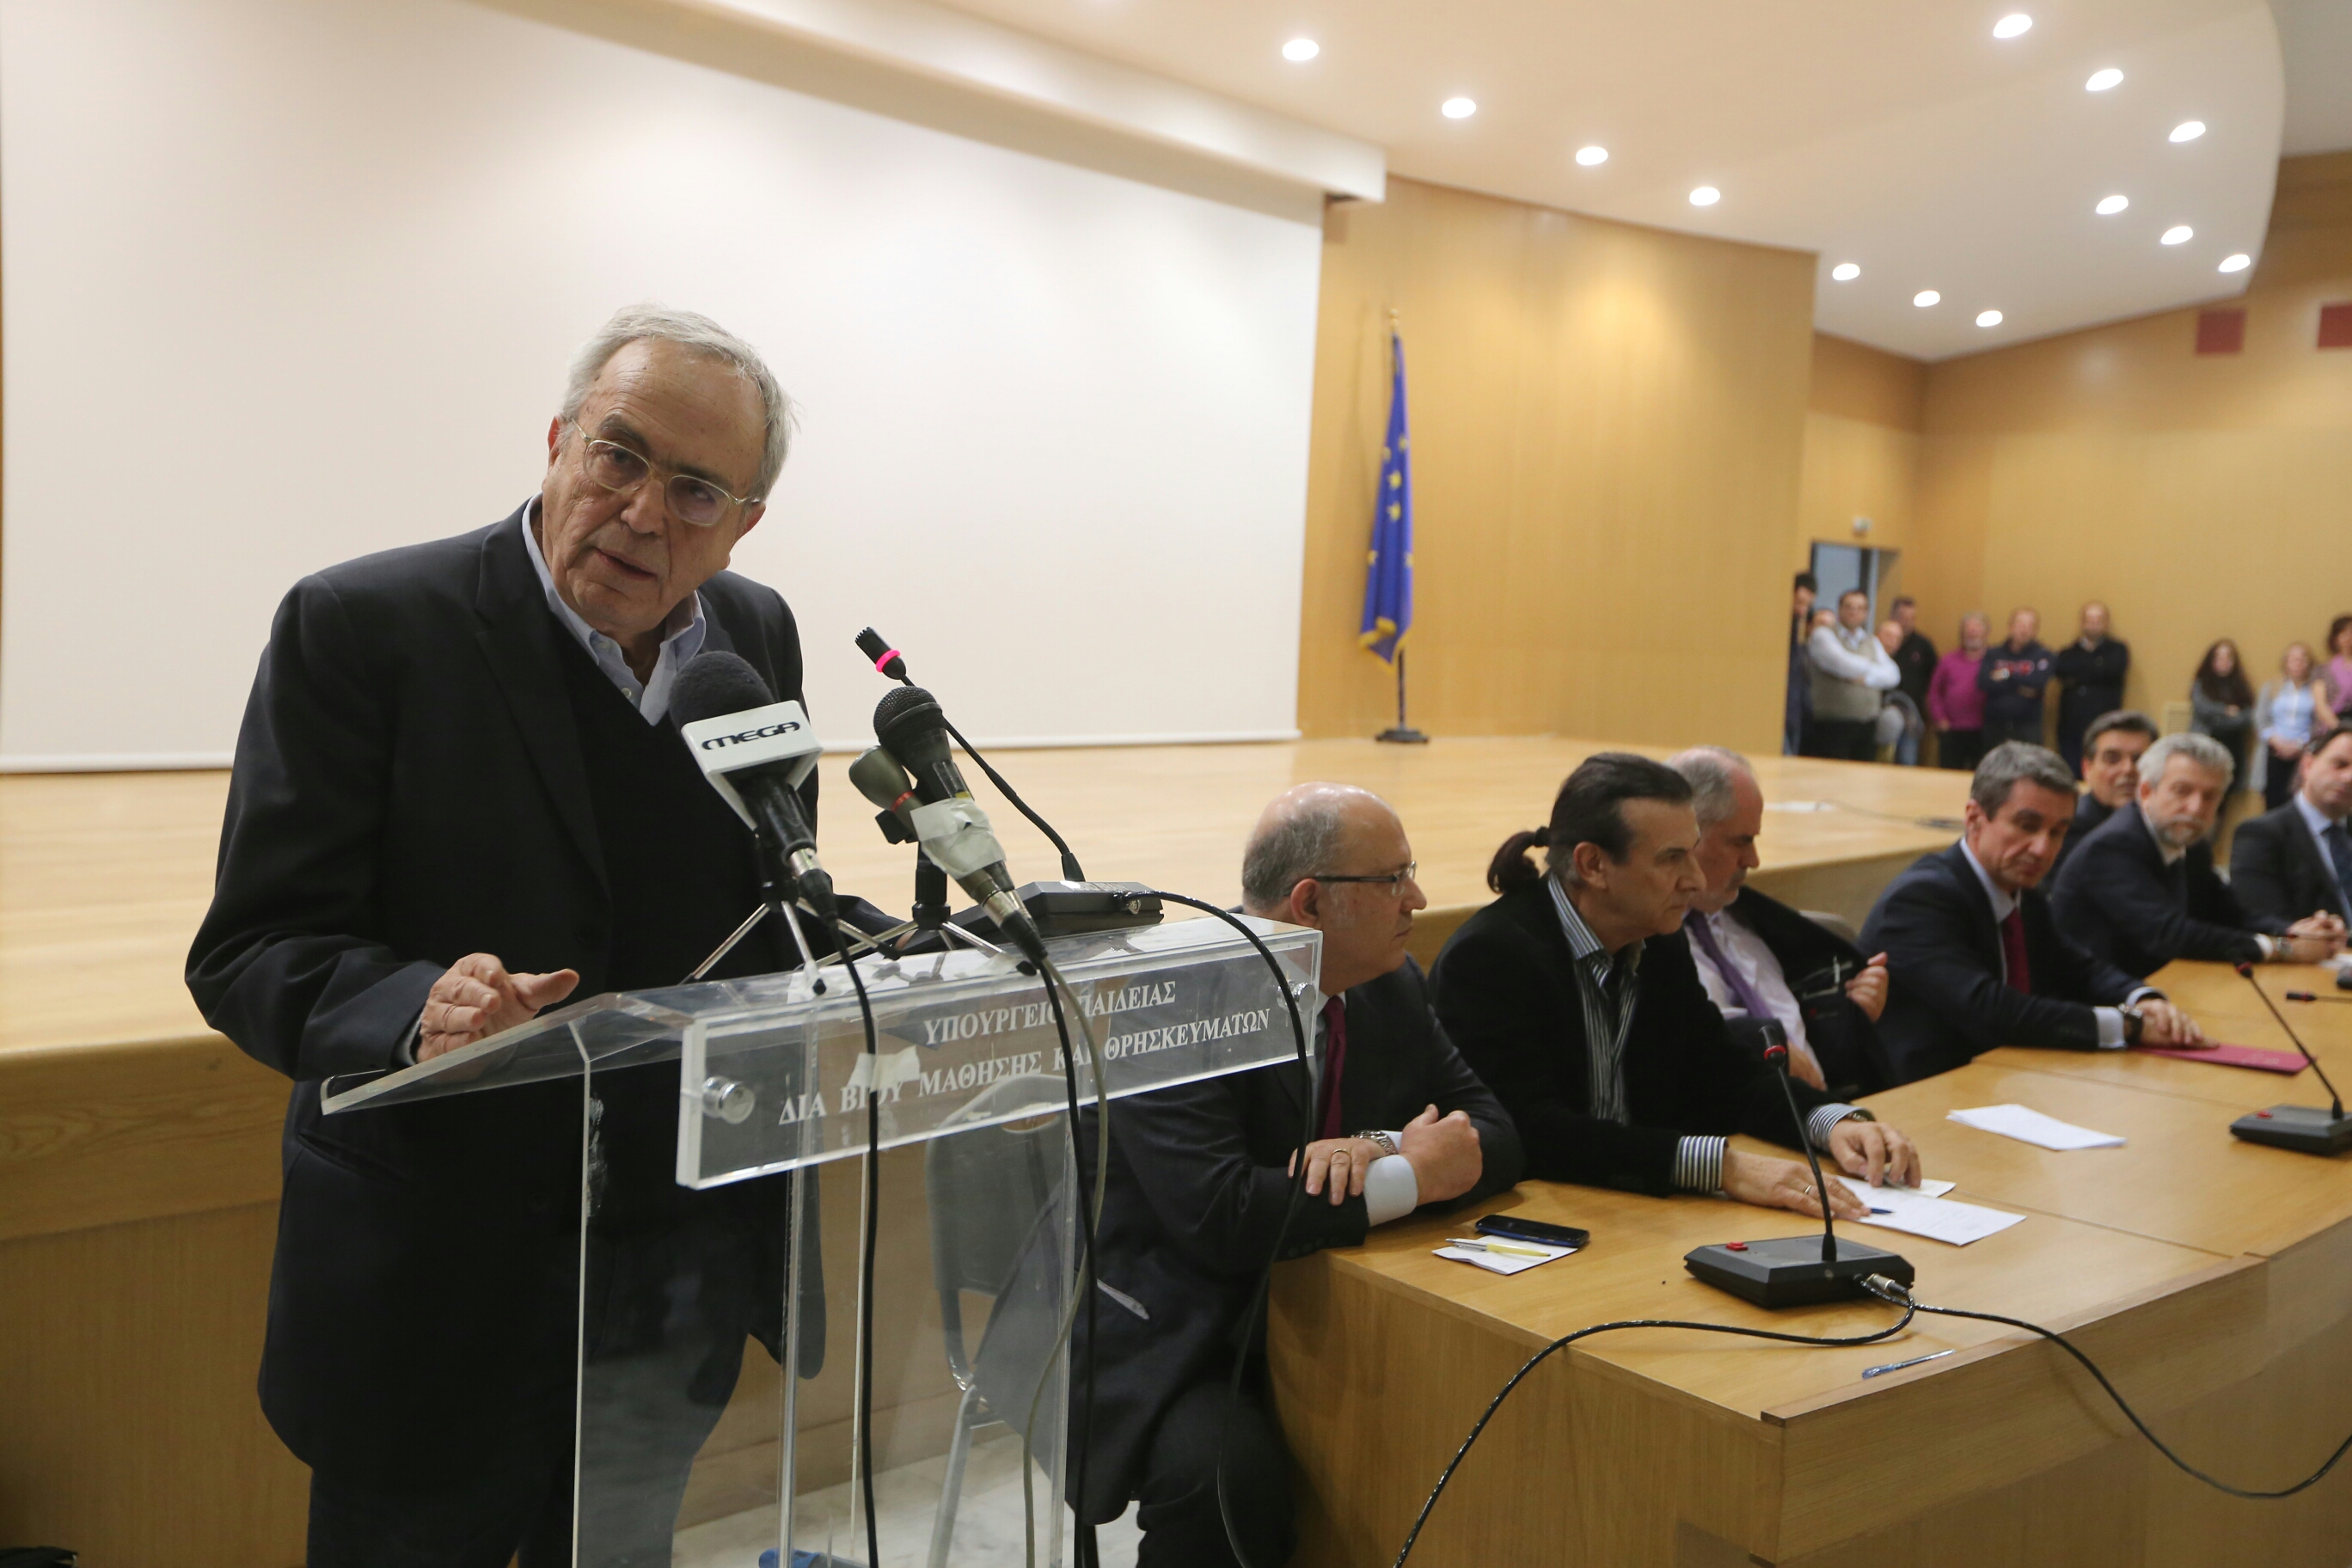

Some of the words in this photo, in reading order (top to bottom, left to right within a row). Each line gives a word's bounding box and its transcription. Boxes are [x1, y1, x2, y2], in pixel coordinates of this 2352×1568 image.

[701, 721, 800, 750] MEGA
[1074, 981, 1177, 1020] ΠΑΙΔΕΙΑΣ
[779, 1091, 827, 1126] ΔΙΑ
[917, 1050, 1042, 1098] ΜΑΘΗΣΗΣ
[1104, 1008, 1271, 1062] ΘΡΗΣΚΕΥΜΑΤΩΝ
